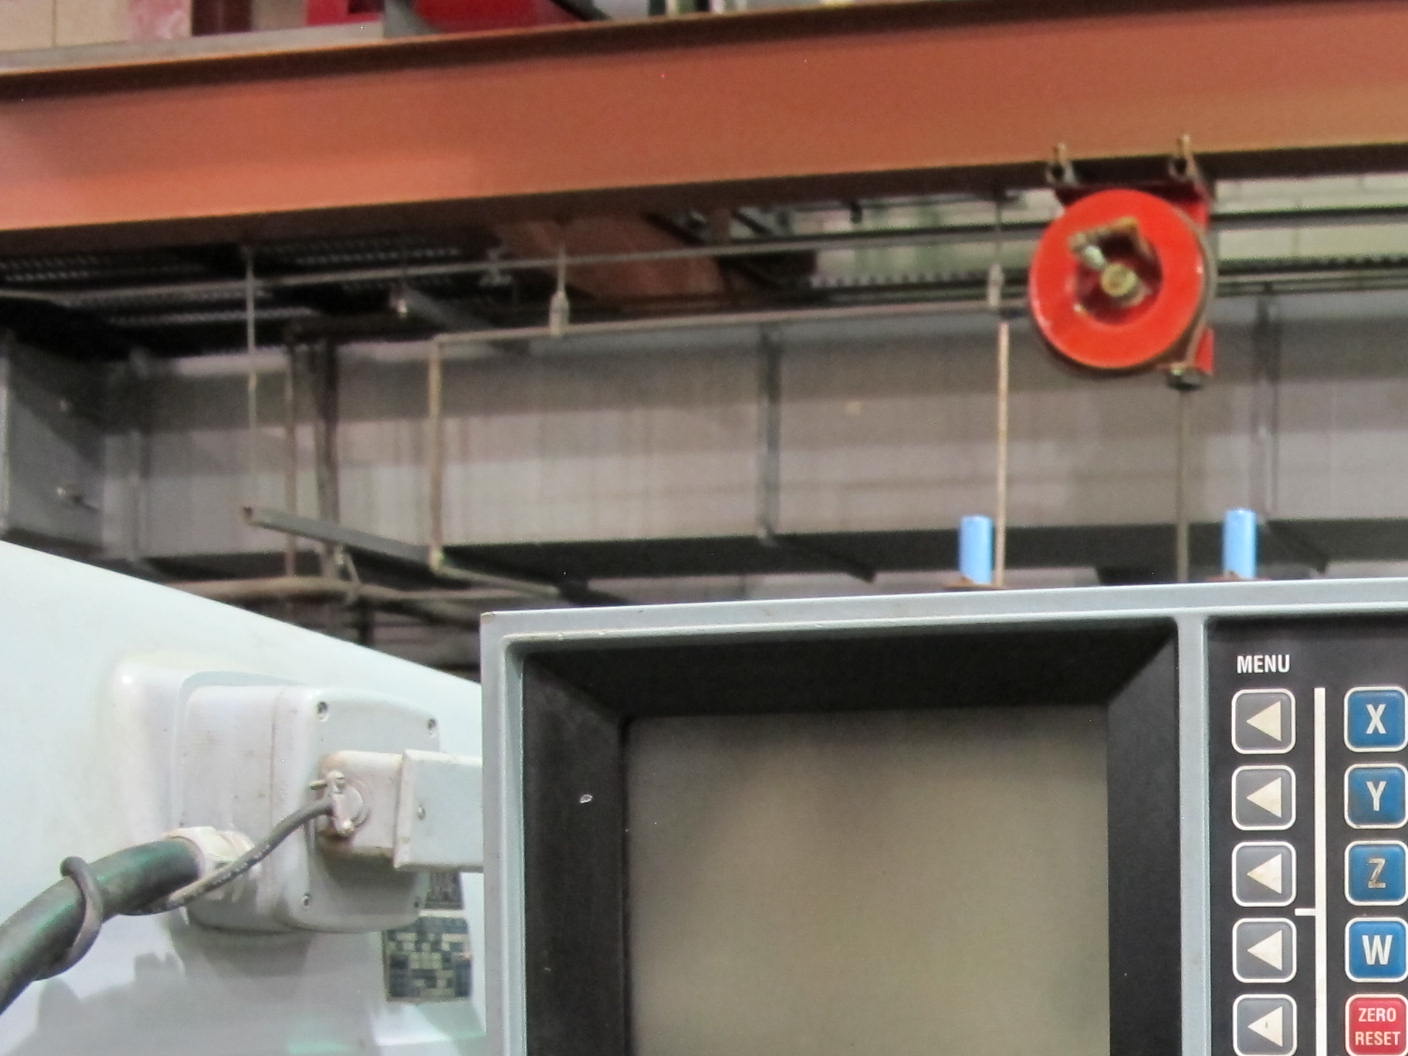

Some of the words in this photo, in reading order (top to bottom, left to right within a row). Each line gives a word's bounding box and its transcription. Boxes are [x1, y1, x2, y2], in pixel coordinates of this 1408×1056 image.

[1237, 654, 1289, 673] MENU
[1366, 704, 1386, 734] X
[1366, 781, 1386, 811] Y
[1368, 856, 1386, 888] Z
[1362, 935, 1392, 965] W
[1359, 1008, 1396, 1022] ZERO
[1356, 1031, 1401, 1045] RESET
